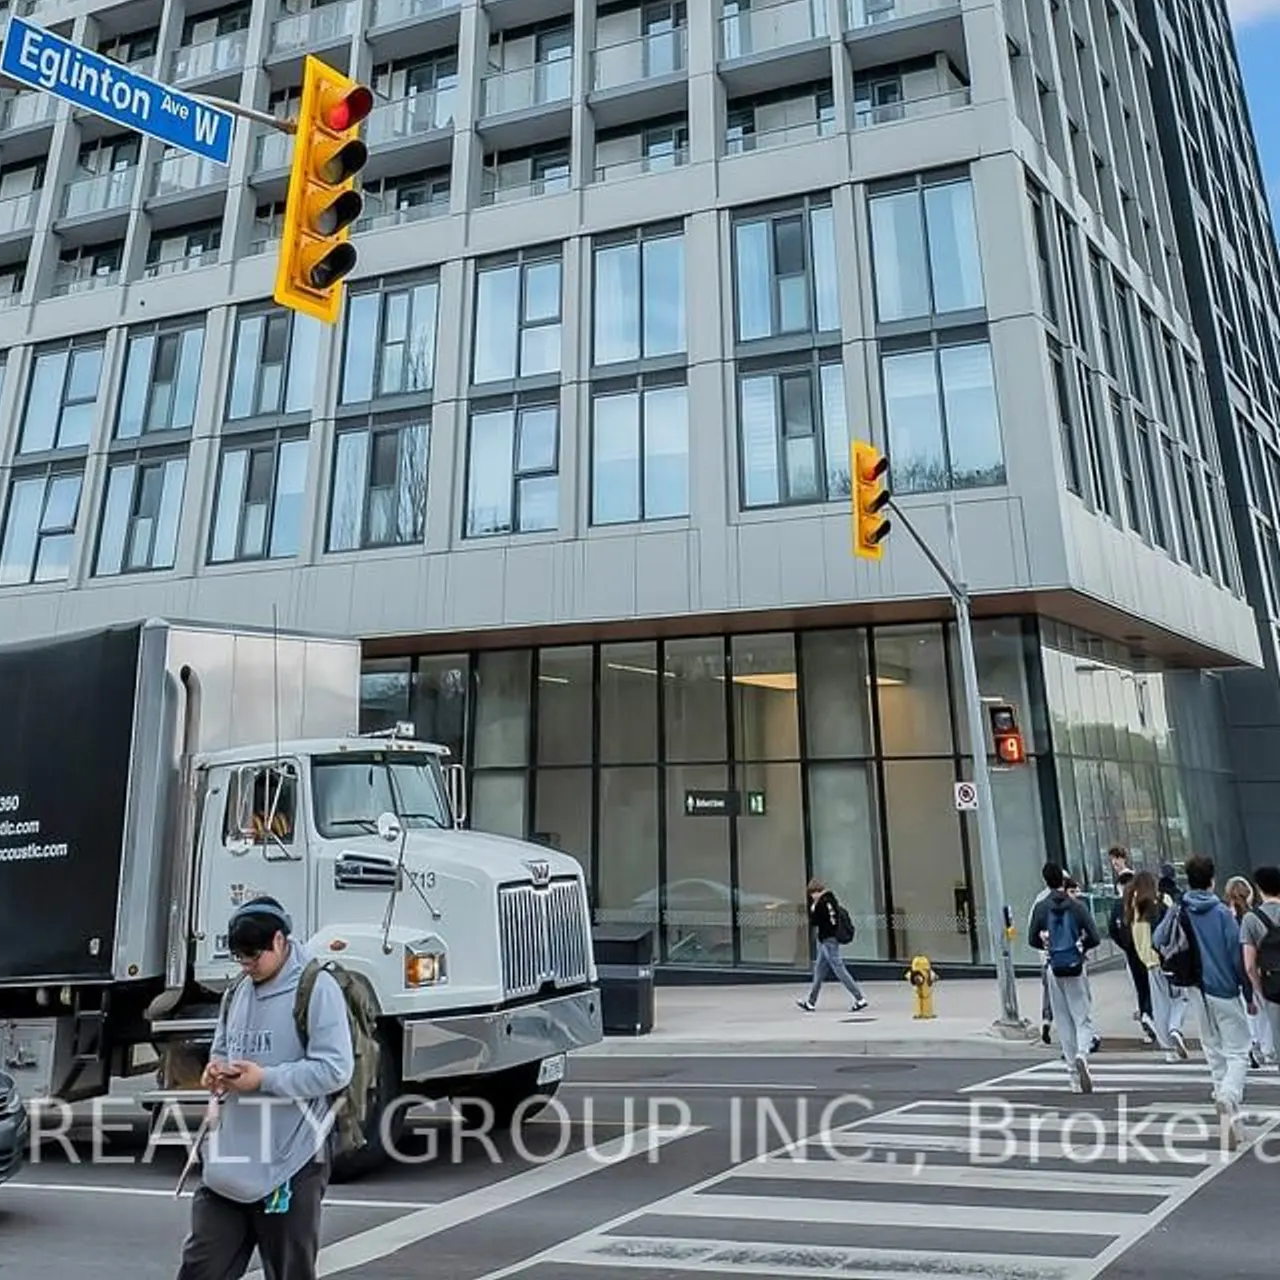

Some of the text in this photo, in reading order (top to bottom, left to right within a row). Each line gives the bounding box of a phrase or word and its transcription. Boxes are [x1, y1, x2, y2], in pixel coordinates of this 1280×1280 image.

[18, 29, 221, 145] Eglinton Ave W
[409, 871, 437, 889] 713
